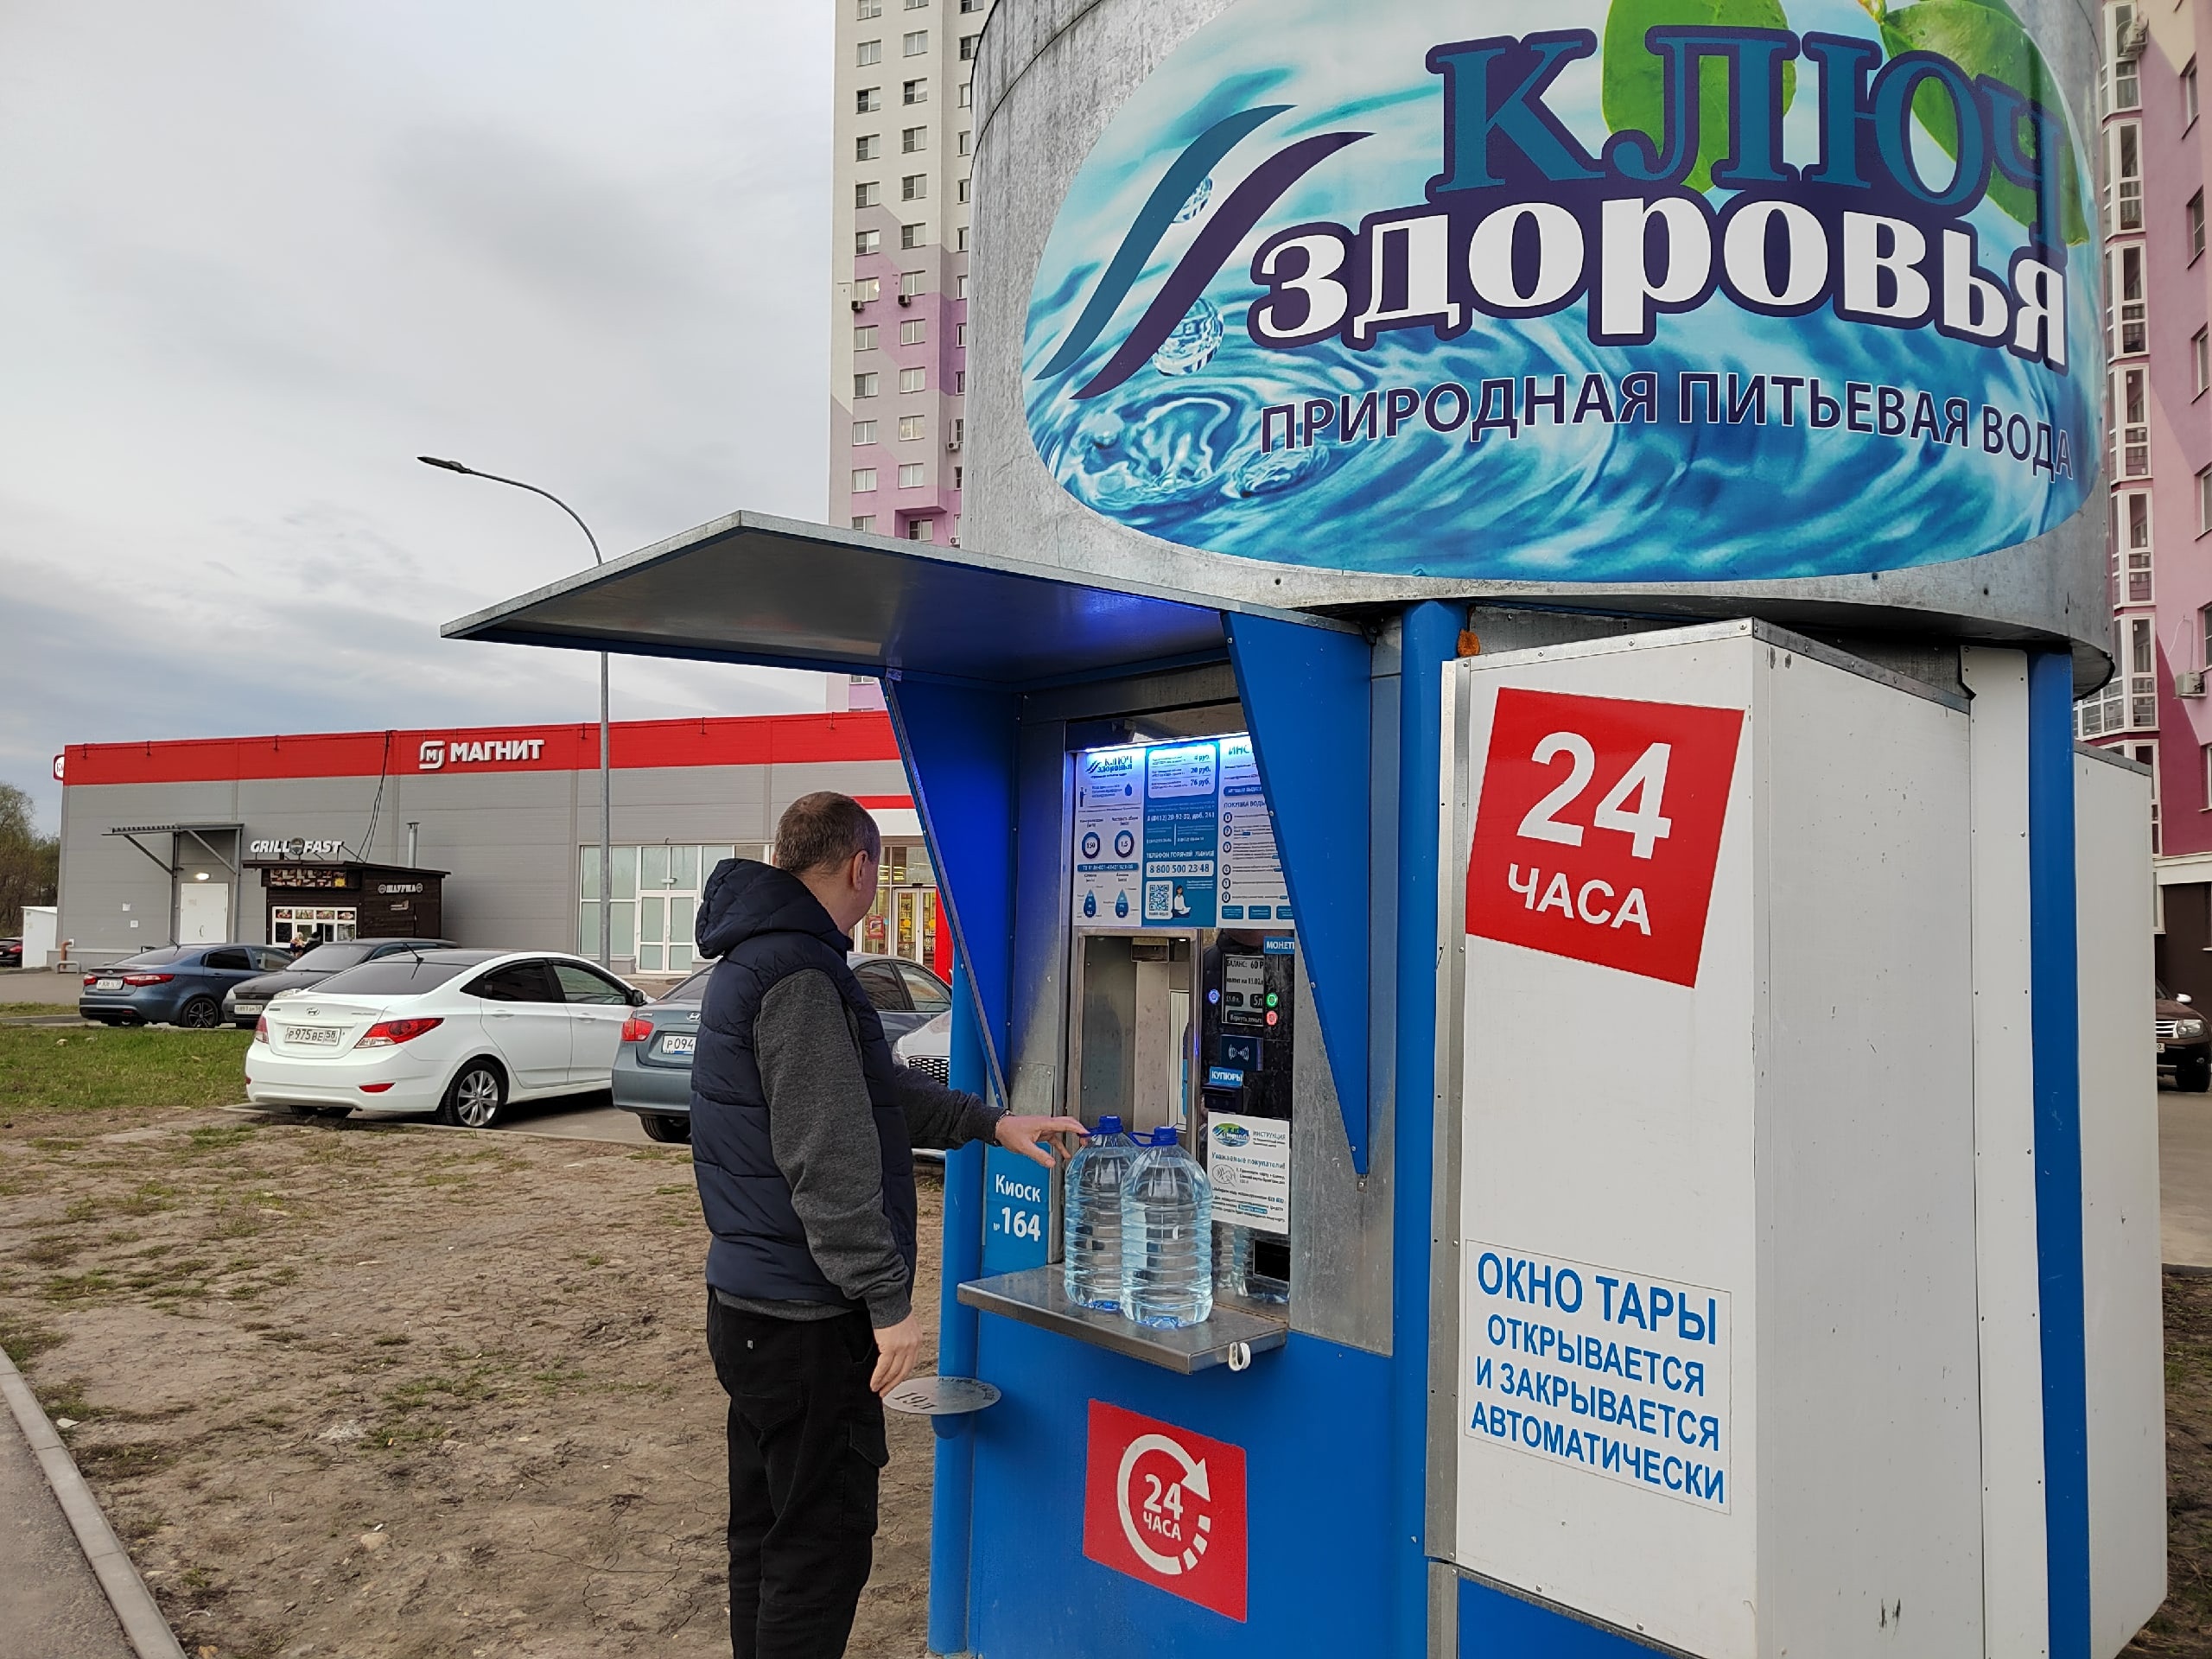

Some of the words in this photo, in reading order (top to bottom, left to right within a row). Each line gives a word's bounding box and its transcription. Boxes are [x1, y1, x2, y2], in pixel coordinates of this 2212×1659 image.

[1428, 29, 2070, 256] КЛЮЧ
[1261, 372, 1658, 454] ПРИРОДНАЯ
[1679, 372, 1971, 447] ПИТЬЕВАЯ
[1982, 404, 2074, 482] ВОДА
[450, 739, 545, 762] МАГНИТ
[1516, 731, 1672, 860] 24
[250, 839, 290, 854] GRILL
[302, 839, 343, 854] FAST
[1149, 865, 1154, 874] 8
[1156, 865, 1171, 874] 800
[1172, 865, 1186, 874] 500
[1508, 863, 1652, 936] ЧАСА
[1250, 960, 1259, 969] 60
[666, 1038, 695, 1050] Р094
[1211, 1070, 1243, 1082] КУПЮРЫ
[1211, 1152, 1247, 1164] Уважаемые
[1247, 1159, 1286, 1170] покупатели!
[995, 1173, 1041, 1203] Киоск
[1478, 1252, 1583, 1313] ОКНО
[1595, 1274, 1716, 1345] ТАРЫ
[1487, 1313, 1704, 1397] ОТКРЫВАЕТСЯ
[1476, 1355, 1491, 1389] И
[1500, 1363, 1719, 1452] ЗАКРЫВАЕТСЯ
[1471, 1401, 1724, 1504] АВТОМАТИЧЕСКИ
[1143, 1473, 1184, 1521] 24
[1142, 1510, 1182, 1542] ЧАСА
